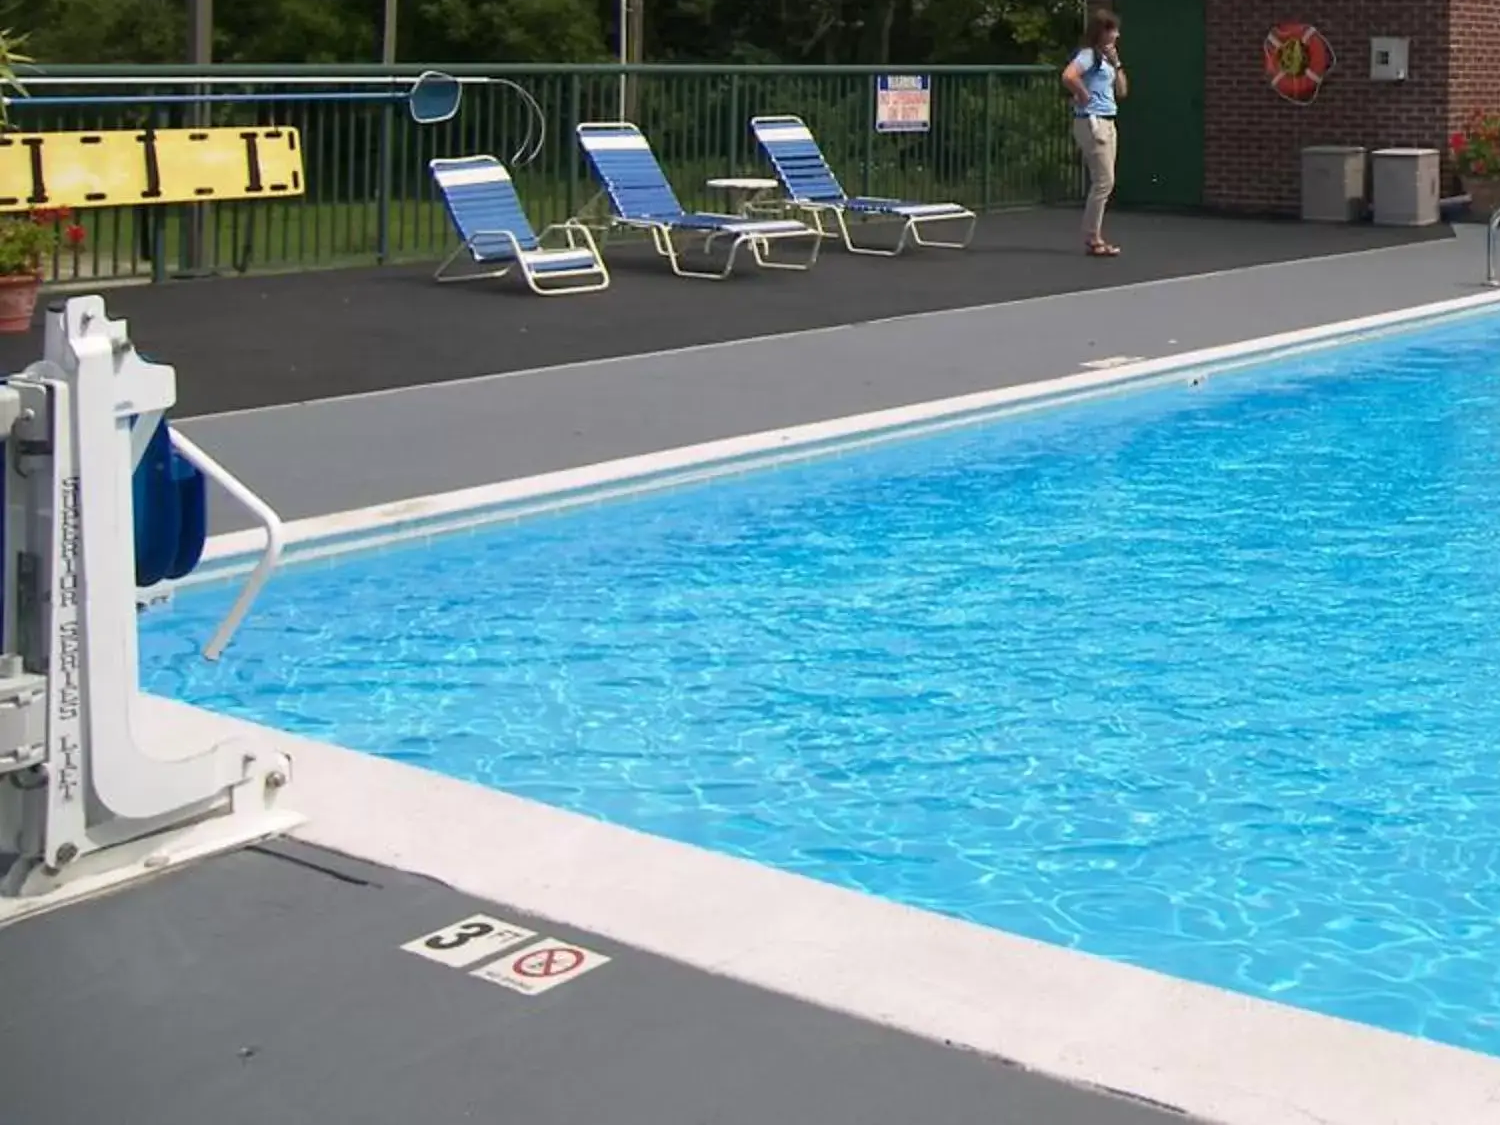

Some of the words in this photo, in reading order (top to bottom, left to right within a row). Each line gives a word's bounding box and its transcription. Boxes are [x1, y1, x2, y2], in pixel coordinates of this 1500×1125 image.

[61, 477, 80, 607] SUPERIOR
[59, 620, 80, 721] SERIES
[59, 735, 77, 802] LIFT
[425, 922, 495, 949] 3
